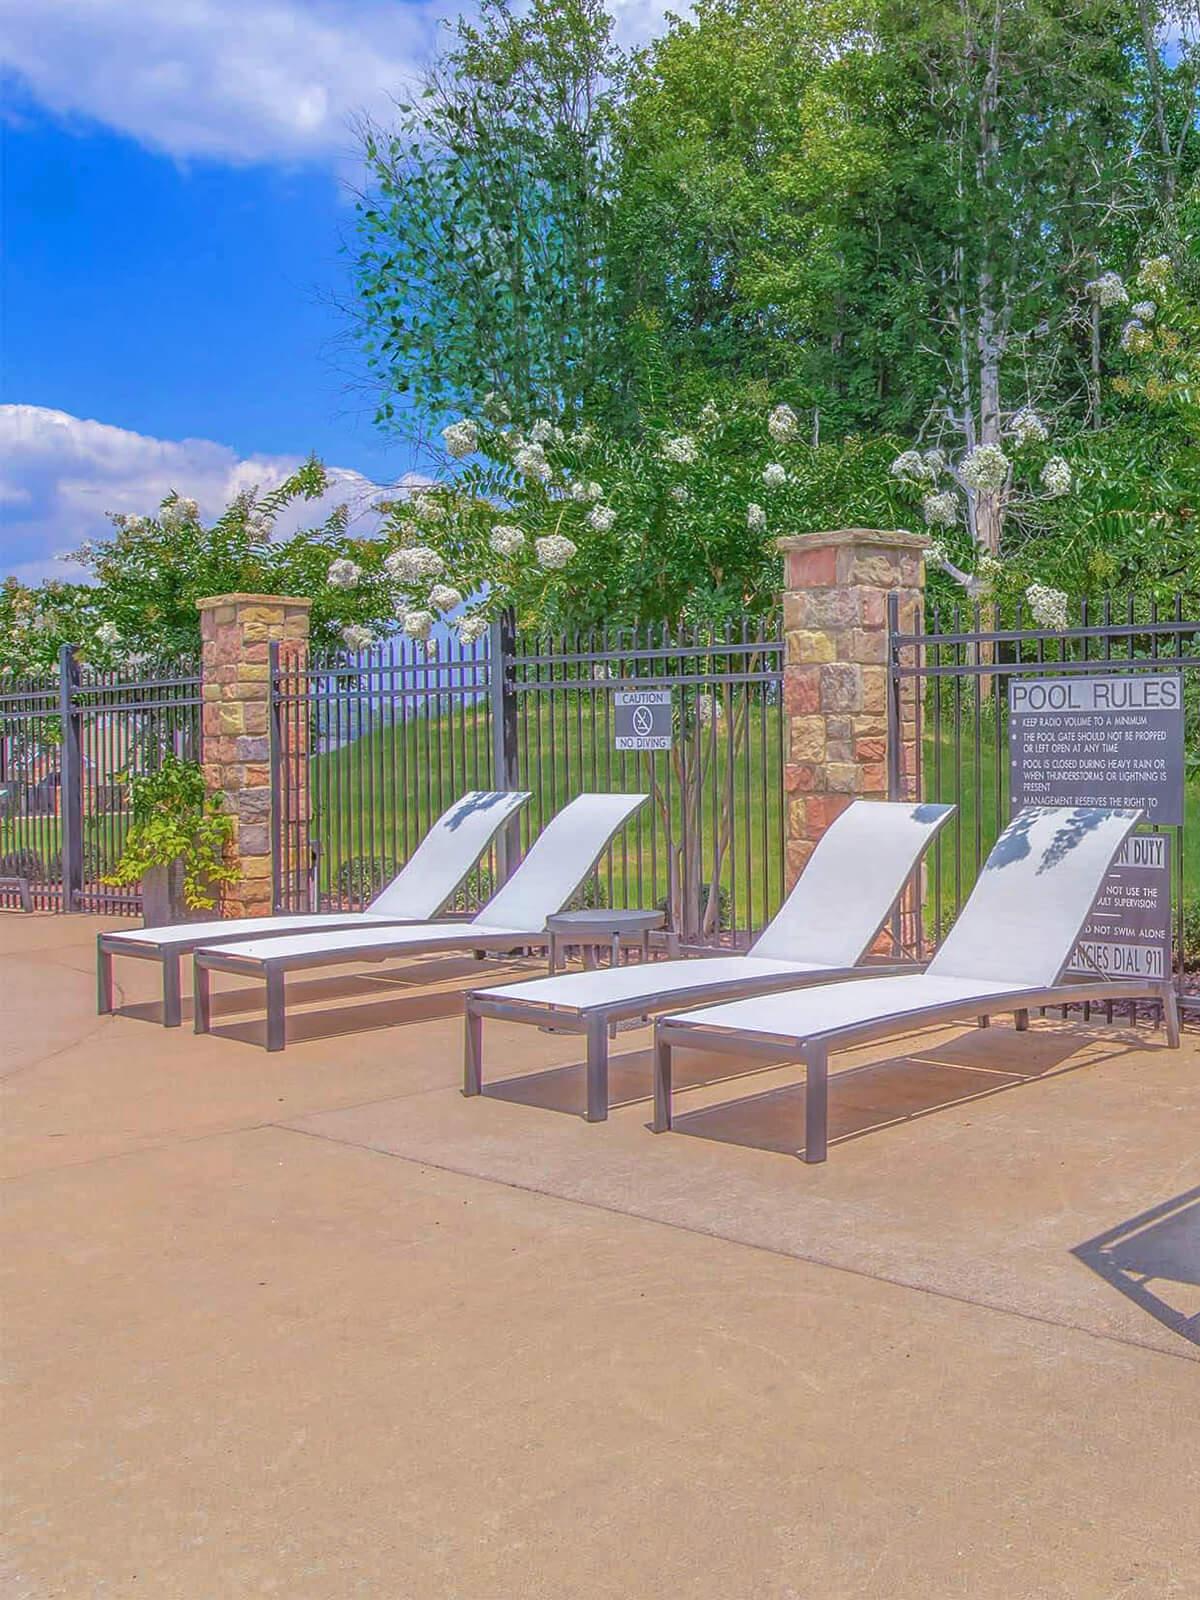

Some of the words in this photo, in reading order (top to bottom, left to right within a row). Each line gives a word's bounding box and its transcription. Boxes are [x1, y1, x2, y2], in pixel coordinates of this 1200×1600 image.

[622, 693, 664, 704] CAUTION
[1013, 684, 1080, 710] POOL
[1094, 680, 1176, 707] RULES
[1023, 718, 1038, 727] KEEP
[1039, 717, 1062, 727] RADIO
[1064, 716, 1092, 727] VOLUME
[1094, 715, 1104, 726] TO
[1106, 716, 1112, 726] A
[1115, 715, 1148, 725] MINIMUM
[1023, 733, 1035, 742] THE
[1036, 732, 1056, 742] POOL
[1057, 732, 1076, 741] GATE
[1077, 731, 1105, 741] SHOULD
[1107, 731, 1123, 741] NOT
[1124, 731, 1134, 741] BE
[1135, 730, 1167, 741] PROPPED
[620, 737, 634, 748] NO
[636, 737, 666, 748] DIVING
[1023, 744, 1034, 753] OR
[1035, 744, 1049, 753] LEFT
[1051, 744, 1071, 753] OPEN
[1072, 744, 1081, 753] AT
[1083, 744, 1100, 753] ANY
[1102, 743, 1119, 753] TIME
[1023, 759, 1042, 769] POOL
[1043, 759, 1050, 769] IS
[1052, 759, 1078, 769] CLOSED
[1079, 759, 1106, 769] DURING
[1107, 759, 1131, 769] HEAVY
[1133, 759, 1152, 769] RAIN
[1154, 759, 1166, 769] OR
[1023, 771, 1045, 781] WHEN
[1046, 771, 1104, 781] THUNDERSTORMS
[1105, 771, 1117, 781] OR
[1119, 771, 1159, 781] LIGHTNING
[1160, 771, 1167, 781] IS
[1023, 782, 1051, 792] PRESENT
[1023, 796, 1073, 806] MANAGEMENT
[1074, 796, 1107, 806] RESERVES
[1109, 796, 1122, 807] THE
[1123, 797, 1145, 807] RIGHT
[1148, 797, 1158, 807] TO
[1134, 840, 1163, 865] DUTY
[1106, 886, 1123, 895] NOT
[1125, 887, 1140, 896] USE
[1143, 888, 1158, 898] THE
[1097, 897, 1111, 906] ULT
[1114, 898, 1157, 909] SUPERVISION
[1093, 925, 1110, 935] NOT
[1113, 927, 1135, 937] SWIM
[1139, 929, 1166, 939] ALONE
[1071, 944, 1109, 970] ENCIES
[1114, 948, 1140, 973] DIAL
[1146, 950, 1161, 975] 911
